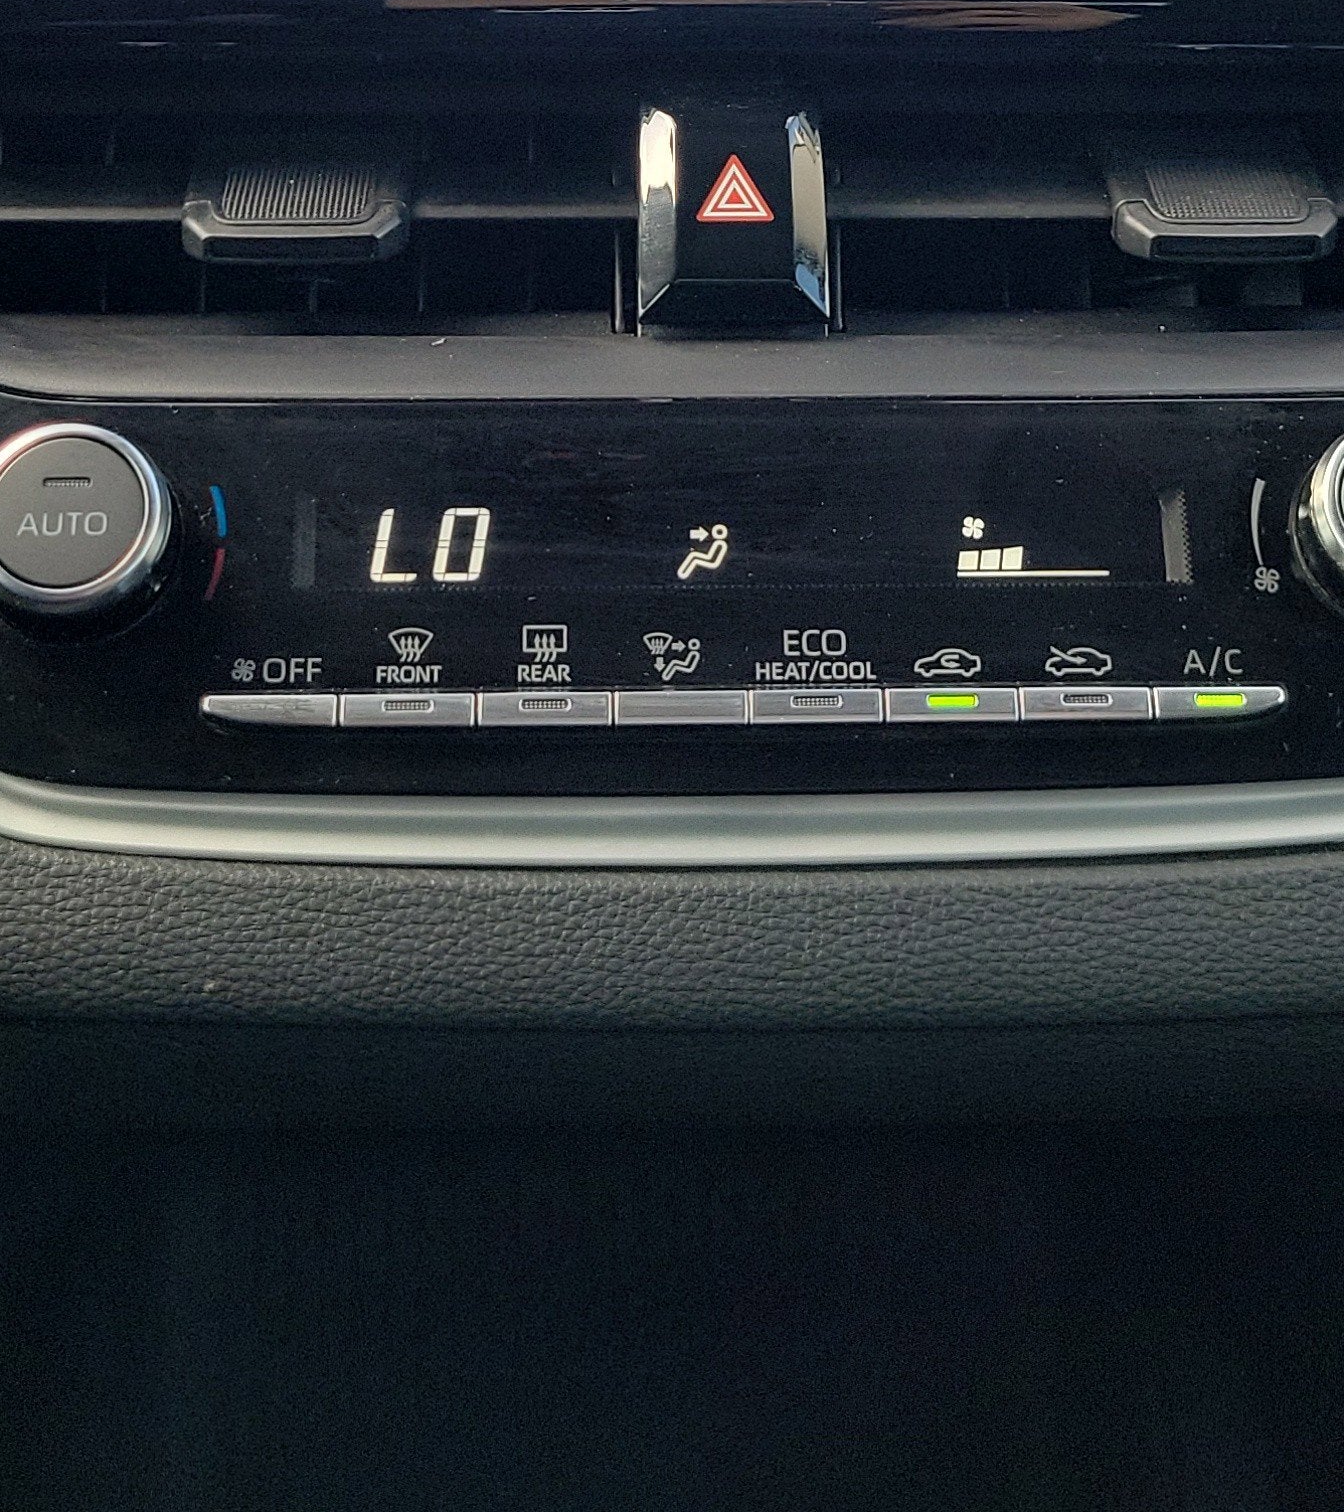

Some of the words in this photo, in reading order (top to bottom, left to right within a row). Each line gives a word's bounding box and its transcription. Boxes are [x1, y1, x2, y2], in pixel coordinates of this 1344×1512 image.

[16, 510, 109, 538] AUTO
[783, 628, 847, 657] ECO
[262, 656, 323, 684] OFF
[375, 664, 443, 684] FRONT
[516, 663, 572, 684] REAR
[755, 660, 877, 681] HEAT/COOL
[1182, 648, 1245, 678] A/C
